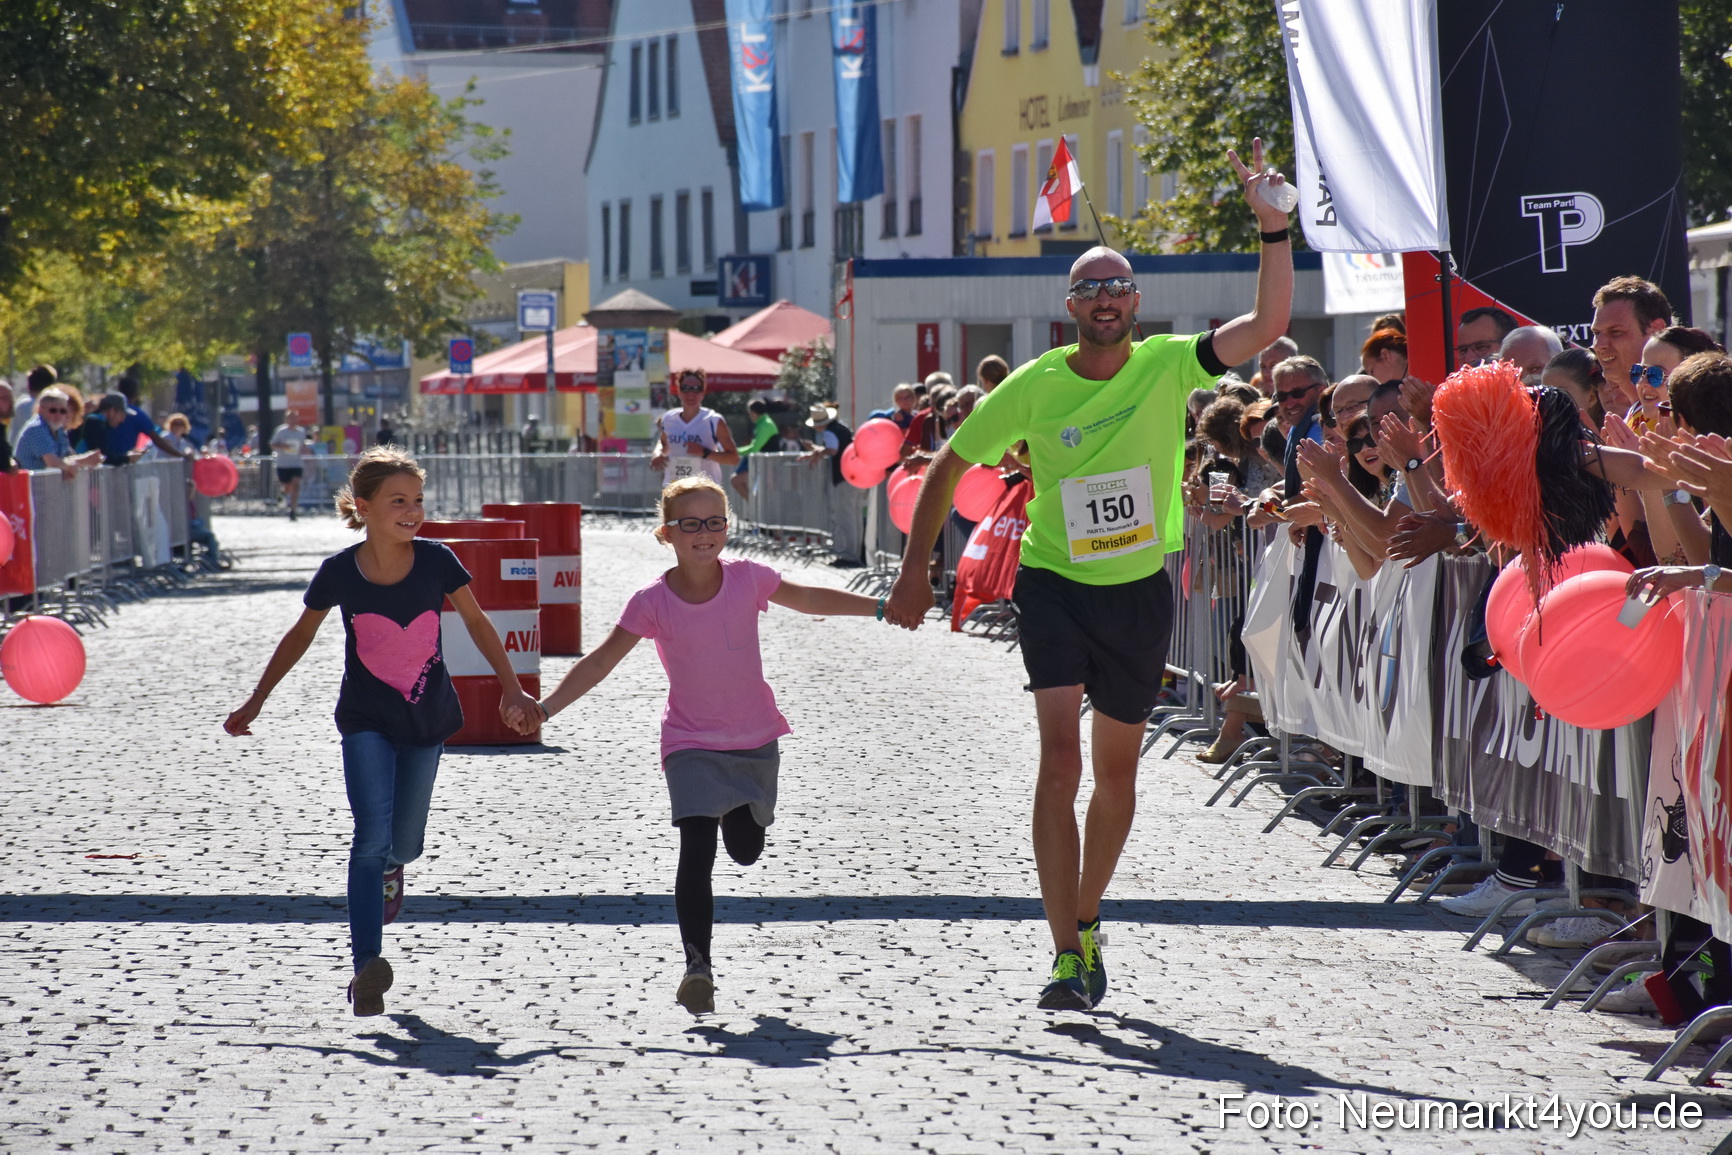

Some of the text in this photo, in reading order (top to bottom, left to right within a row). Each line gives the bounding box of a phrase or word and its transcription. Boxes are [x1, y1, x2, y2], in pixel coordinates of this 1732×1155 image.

[1019, 95, 1051, 131] HOTEL
[1527, 201, 1552, 210] Team
[1520, 191, 1605, 274] TP
[675, 465, 693, 476] 252
[1086, 478, 1128, 493] BOCK
[1086, 493, 1135, 525] 150
[1086, 522, 1133, 535] PARTL Neumarkt
[1091, 533, 1138, 551] Christian
